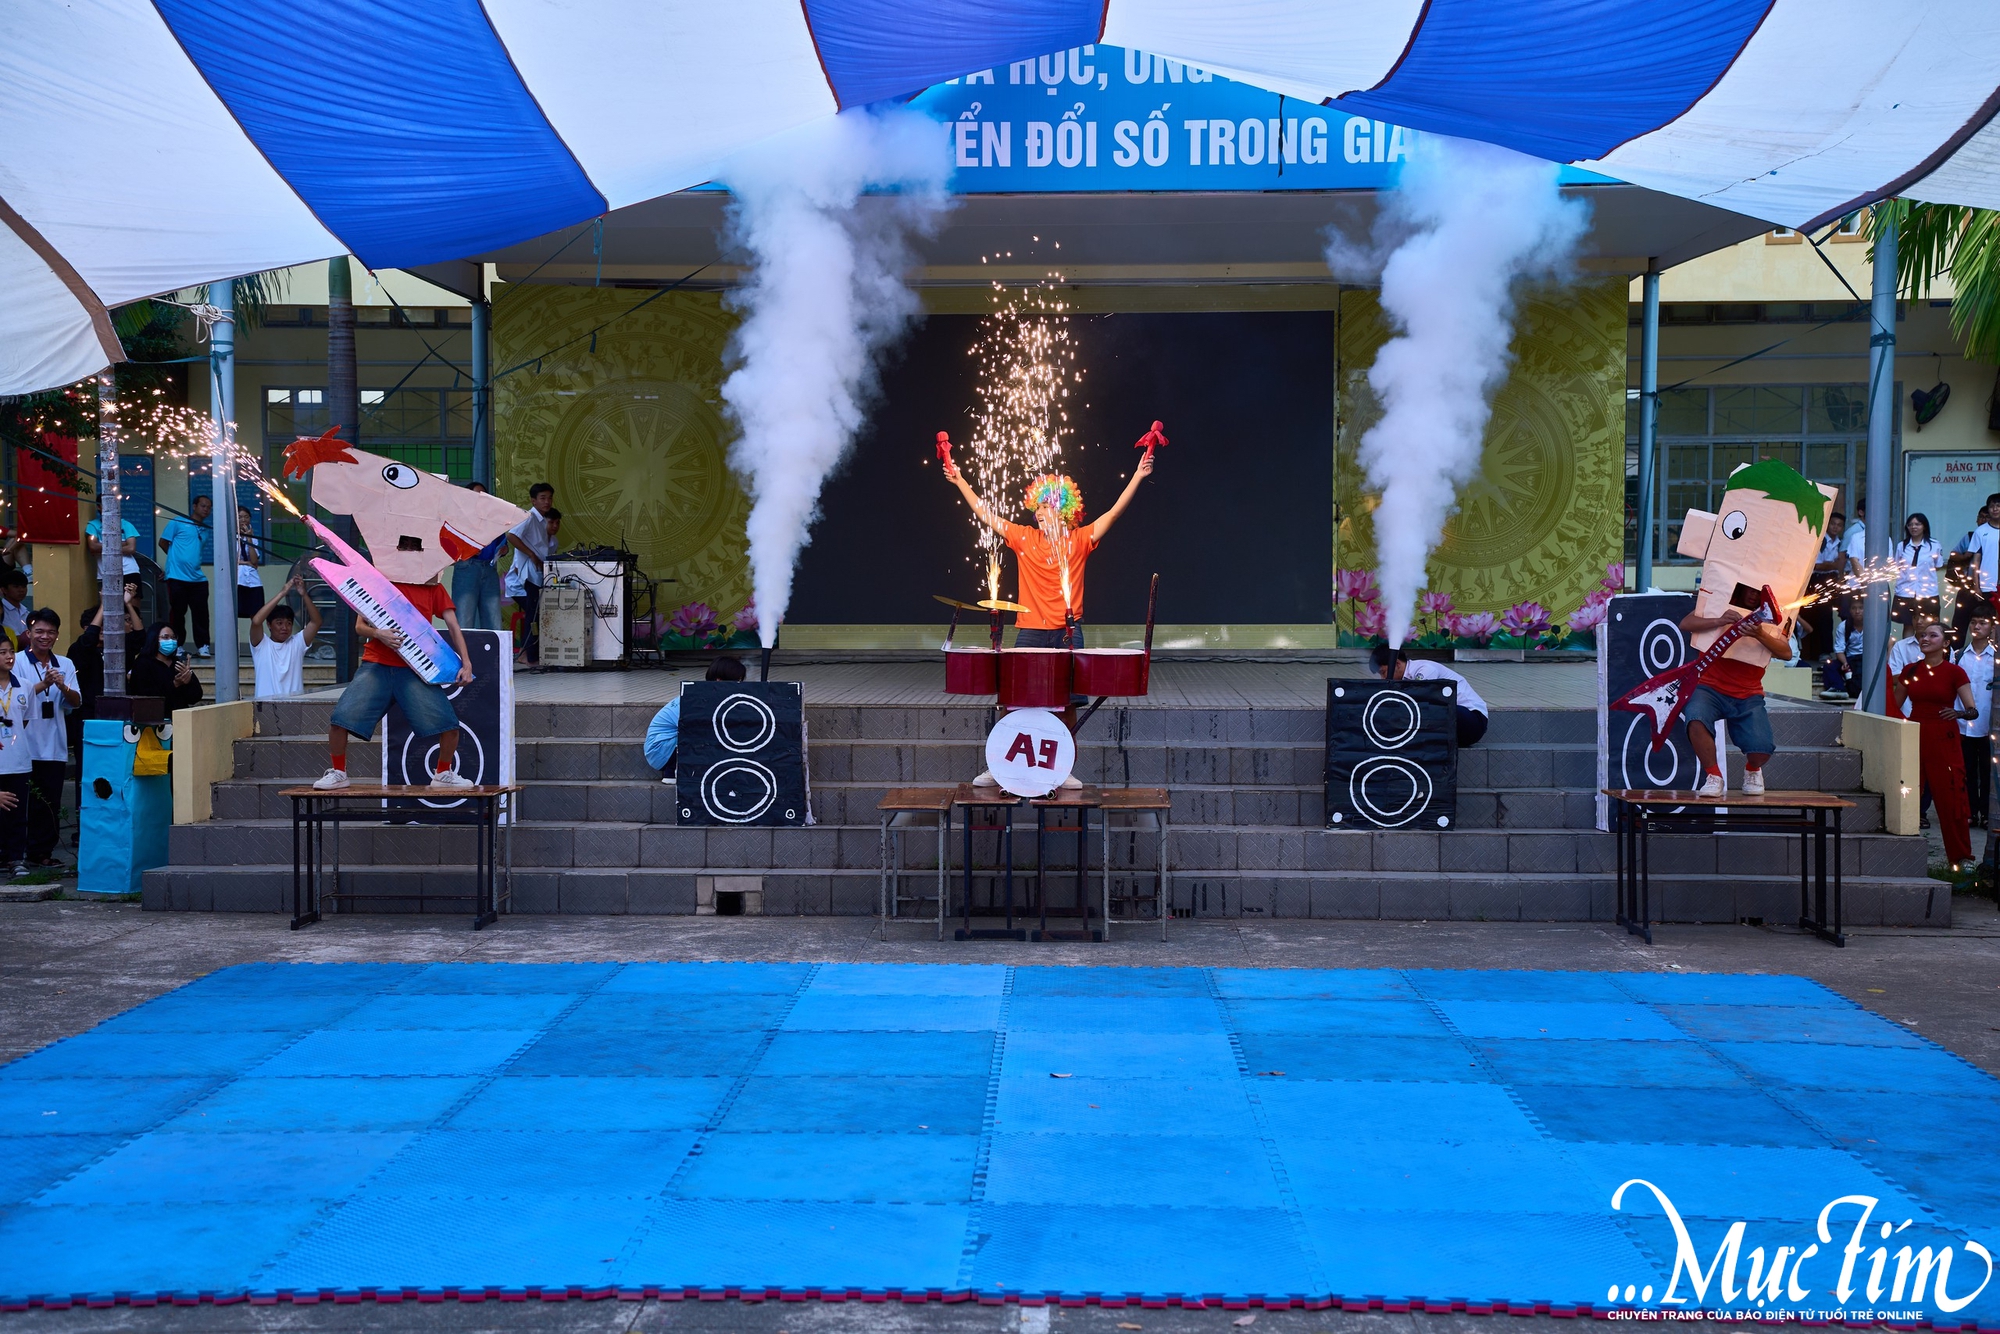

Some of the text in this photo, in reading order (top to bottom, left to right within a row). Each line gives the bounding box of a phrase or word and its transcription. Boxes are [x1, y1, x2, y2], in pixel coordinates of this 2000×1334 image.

[943, 101, 1011, 167] ỂN
[1025, 102, 1097, 168] ĐỔI
[1113, 103, 1172, 167] SỐ
[1184, 117, 1327, 166] TRONG
[1946, 460, 1973, 471] BẢNG
[1976, 462, 1993, 471] TIN
[1931, 473, 1941, 483] TỔ
[1005, 732, 1058, 770] A9
